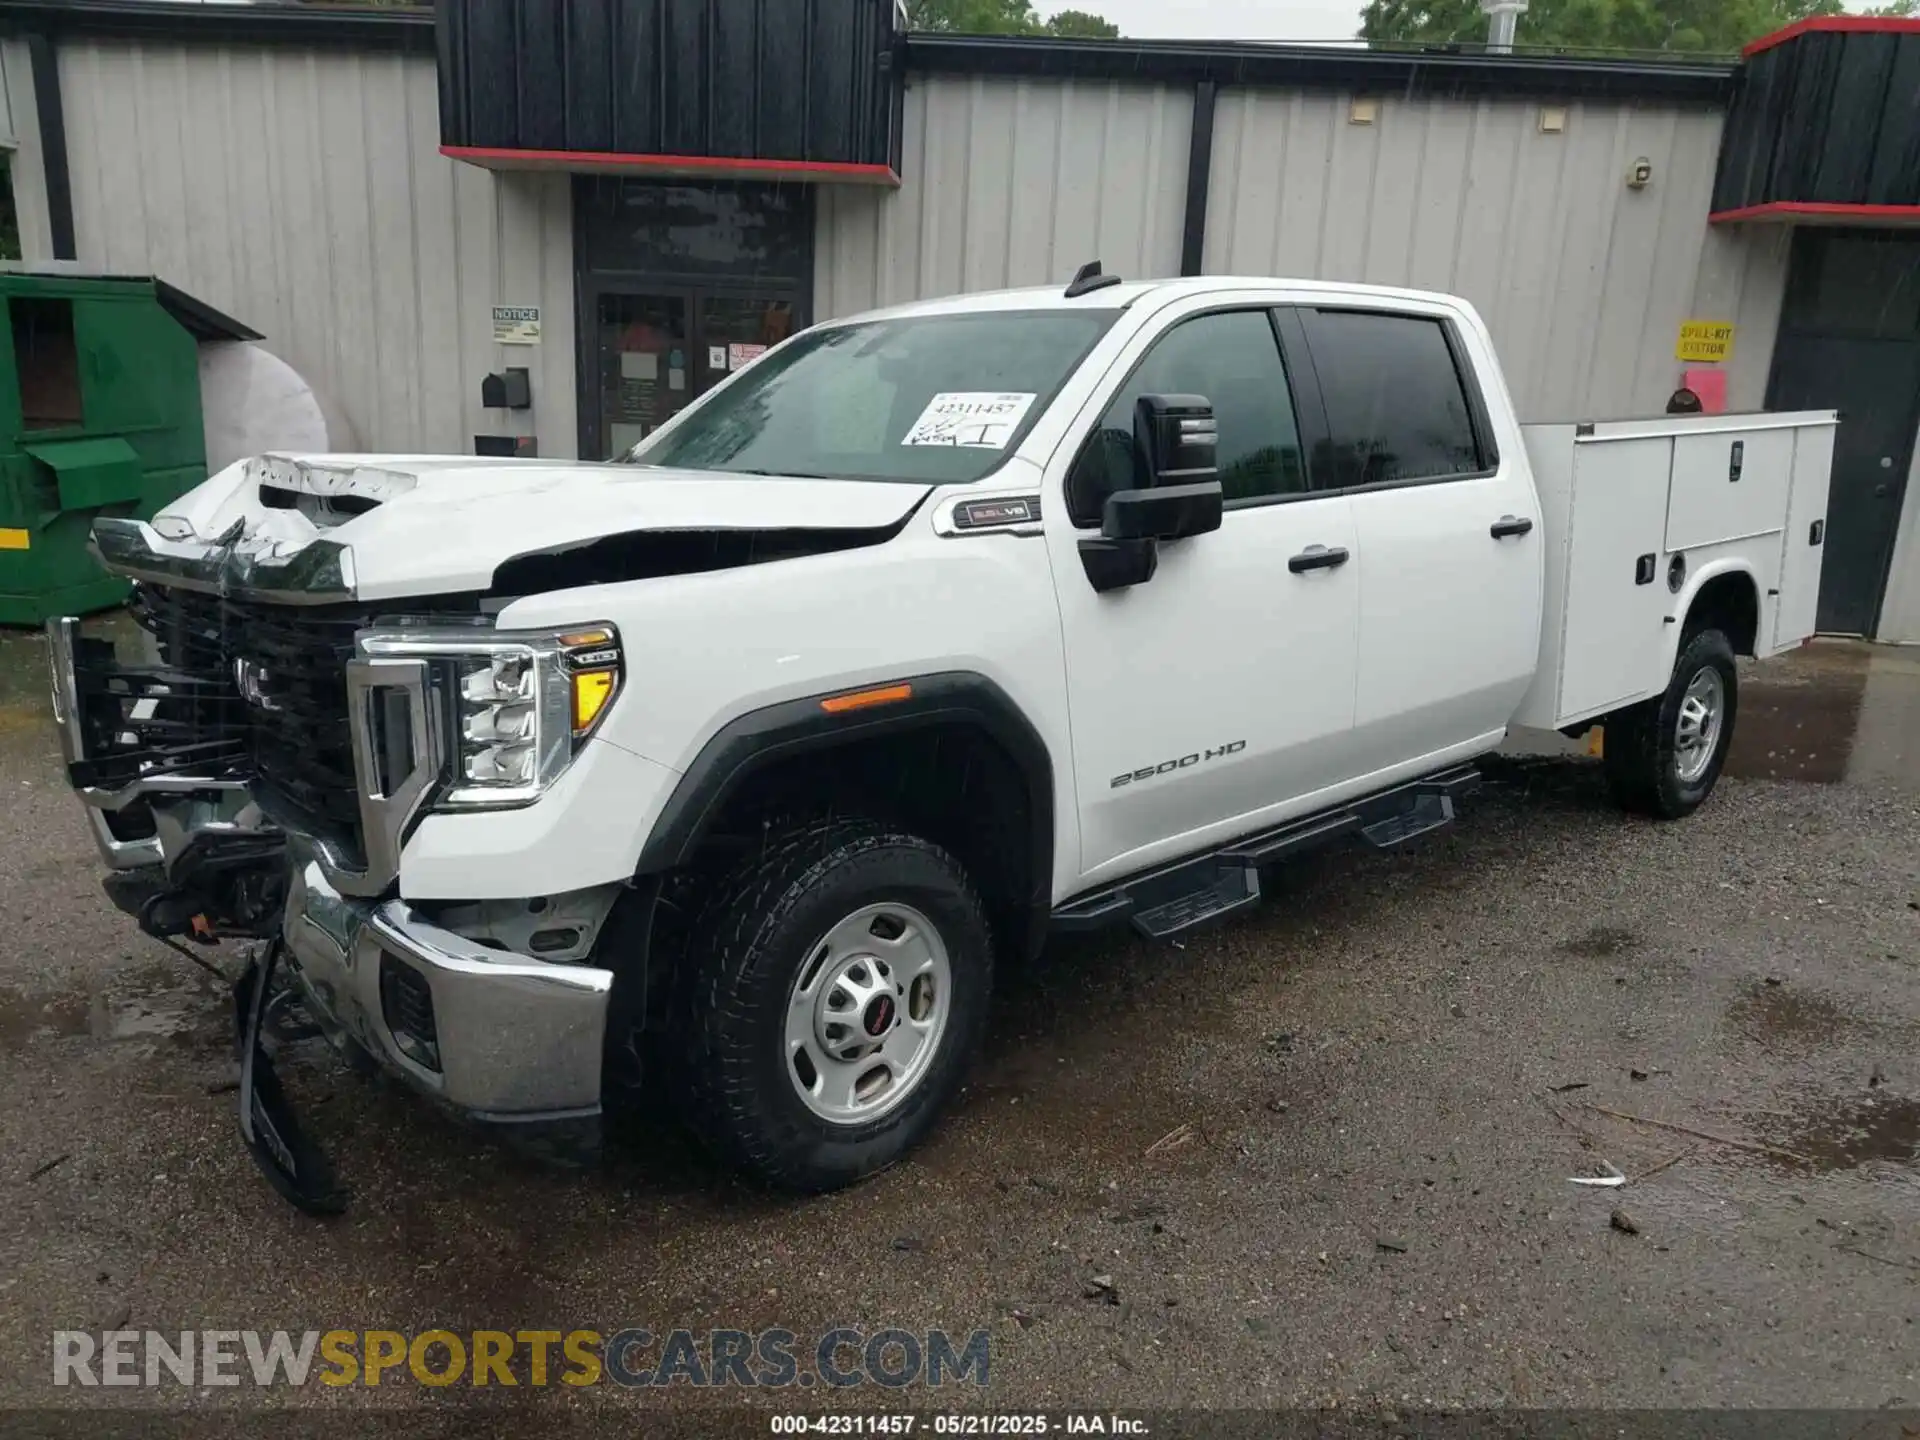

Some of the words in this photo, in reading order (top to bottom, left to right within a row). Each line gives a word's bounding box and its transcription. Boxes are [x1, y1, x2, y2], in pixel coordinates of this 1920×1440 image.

[494, 309, 537, 320] NOTICE
[1110, 753, 1199, 789] 2500
[1204, 740, 1246, 761] HD
